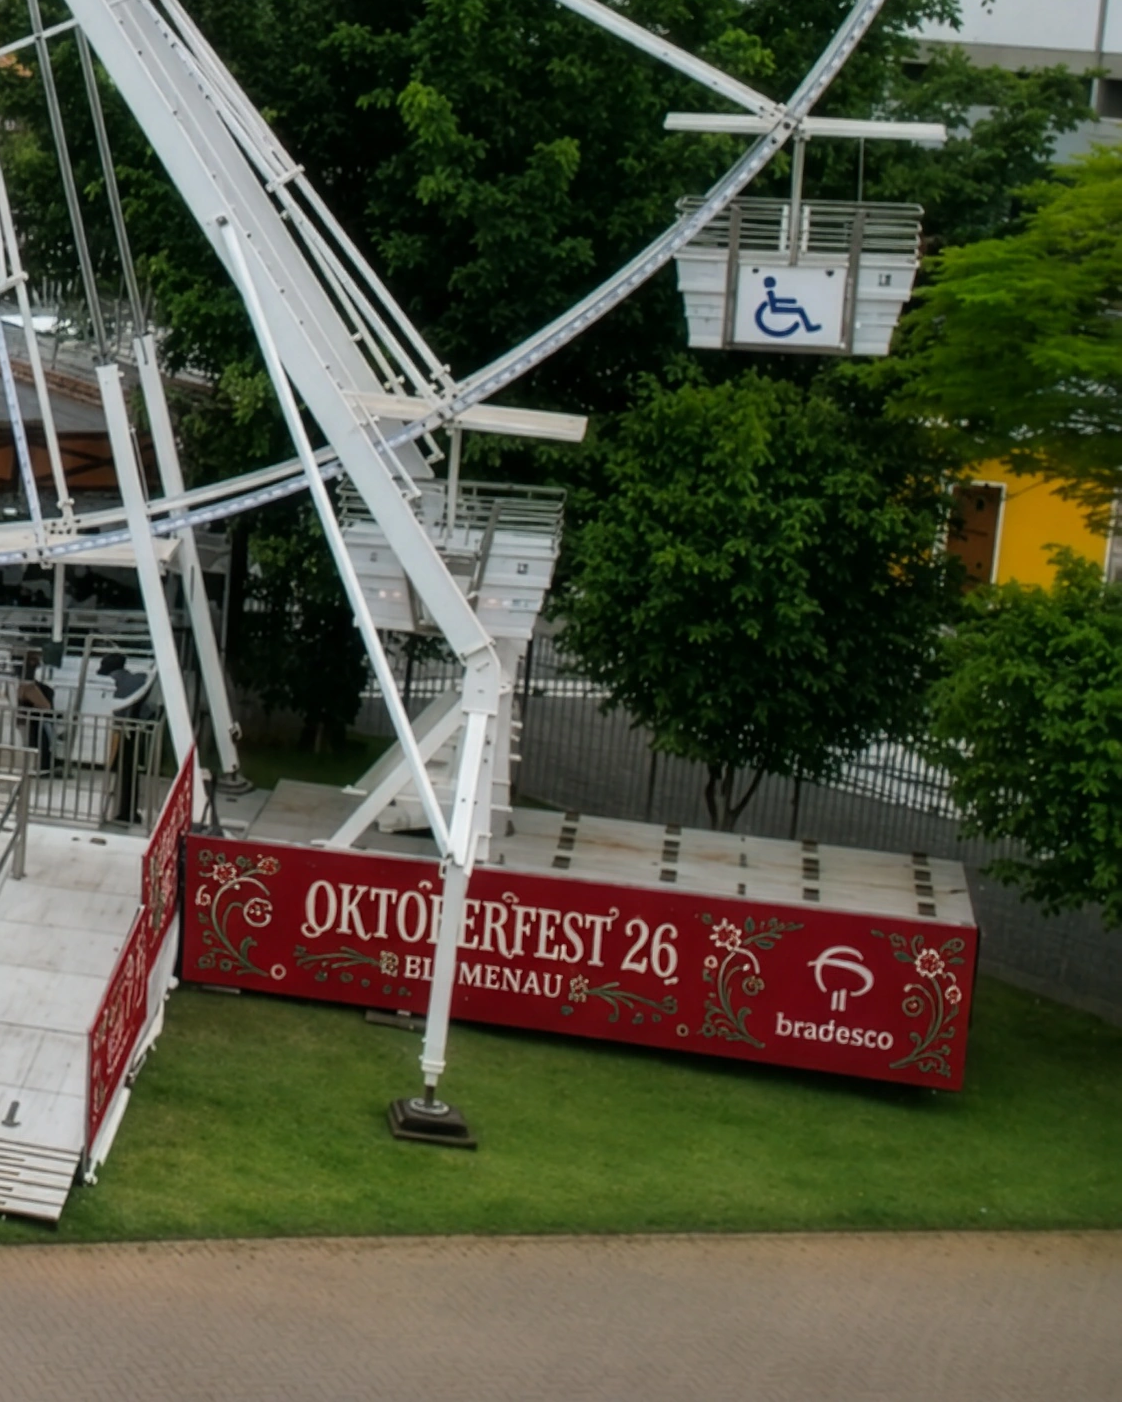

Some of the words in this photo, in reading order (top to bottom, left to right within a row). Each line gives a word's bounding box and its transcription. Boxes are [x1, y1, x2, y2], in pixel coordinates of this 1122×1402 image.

[622, 918, 678, 978] 26
[404, 956, 563, 998] BLMENAU
[776, 1013, 893, 1050] bradesco
